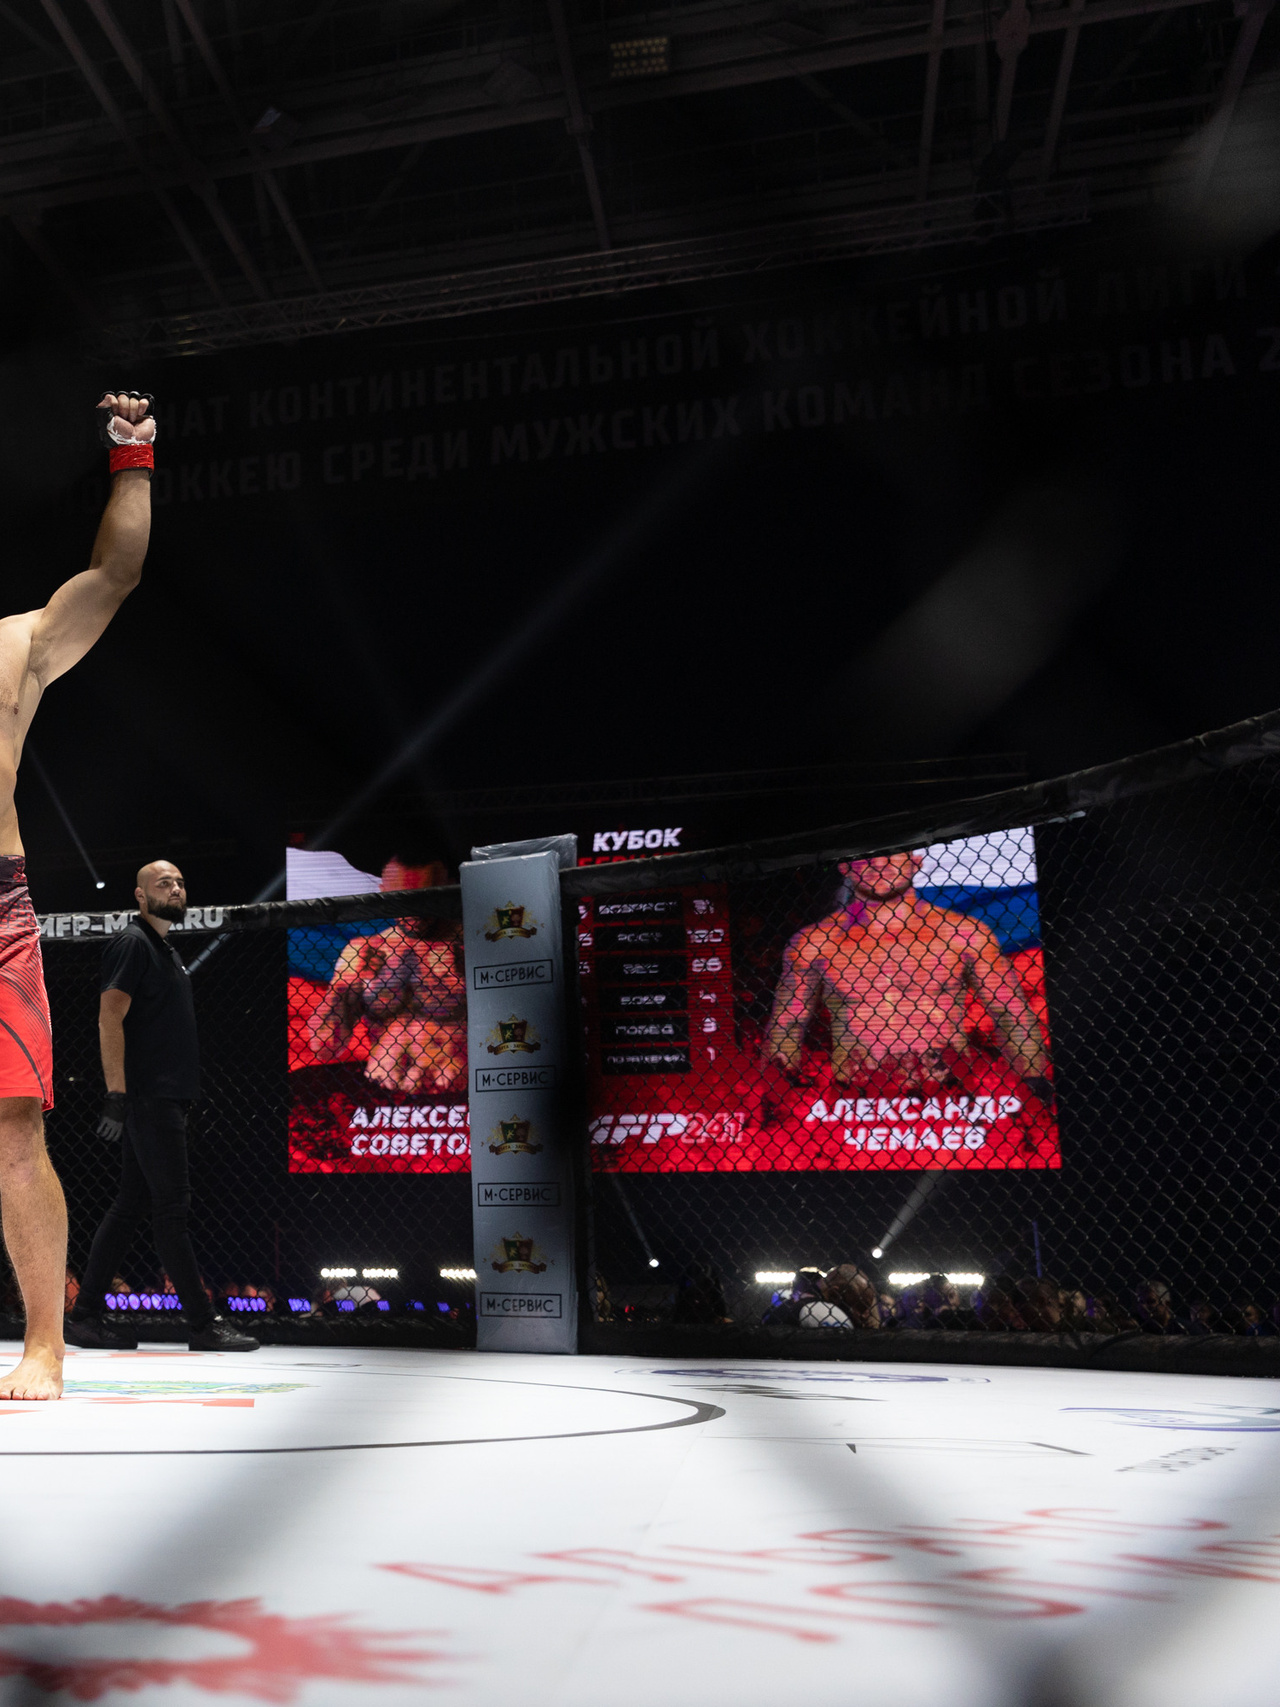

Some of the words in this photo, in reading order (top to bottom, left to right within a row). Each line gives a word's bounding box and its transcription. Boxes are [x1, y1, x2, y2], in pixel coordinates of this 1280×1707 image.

[248, 318, 720, 432] КОНТИНЕНТАЛЬНОЙ
[741, 267, 1067, 364] ХОККЕЙНОЙ
[151, 450, 302, 508] ОККЕЮ
[322, 428, 470, 488] СРЕДИ
[489, 362, 741, 466] МУЖСКИХ
[761, 363, 988, 432] КОМАНД
[1012, 332, 1236, 401] СЕЗОНА
[592, 827, 683, 852] КУБОК
[348, 1105, 470, 1129] АЛЕКСЕ
[806, 1095, 1023, 1124] АЛЕКСАНДР
[351, 1132, 471, 1156] СОВЕТО
[844, 1126, 987, 1151] ЧЕМАЕВ
